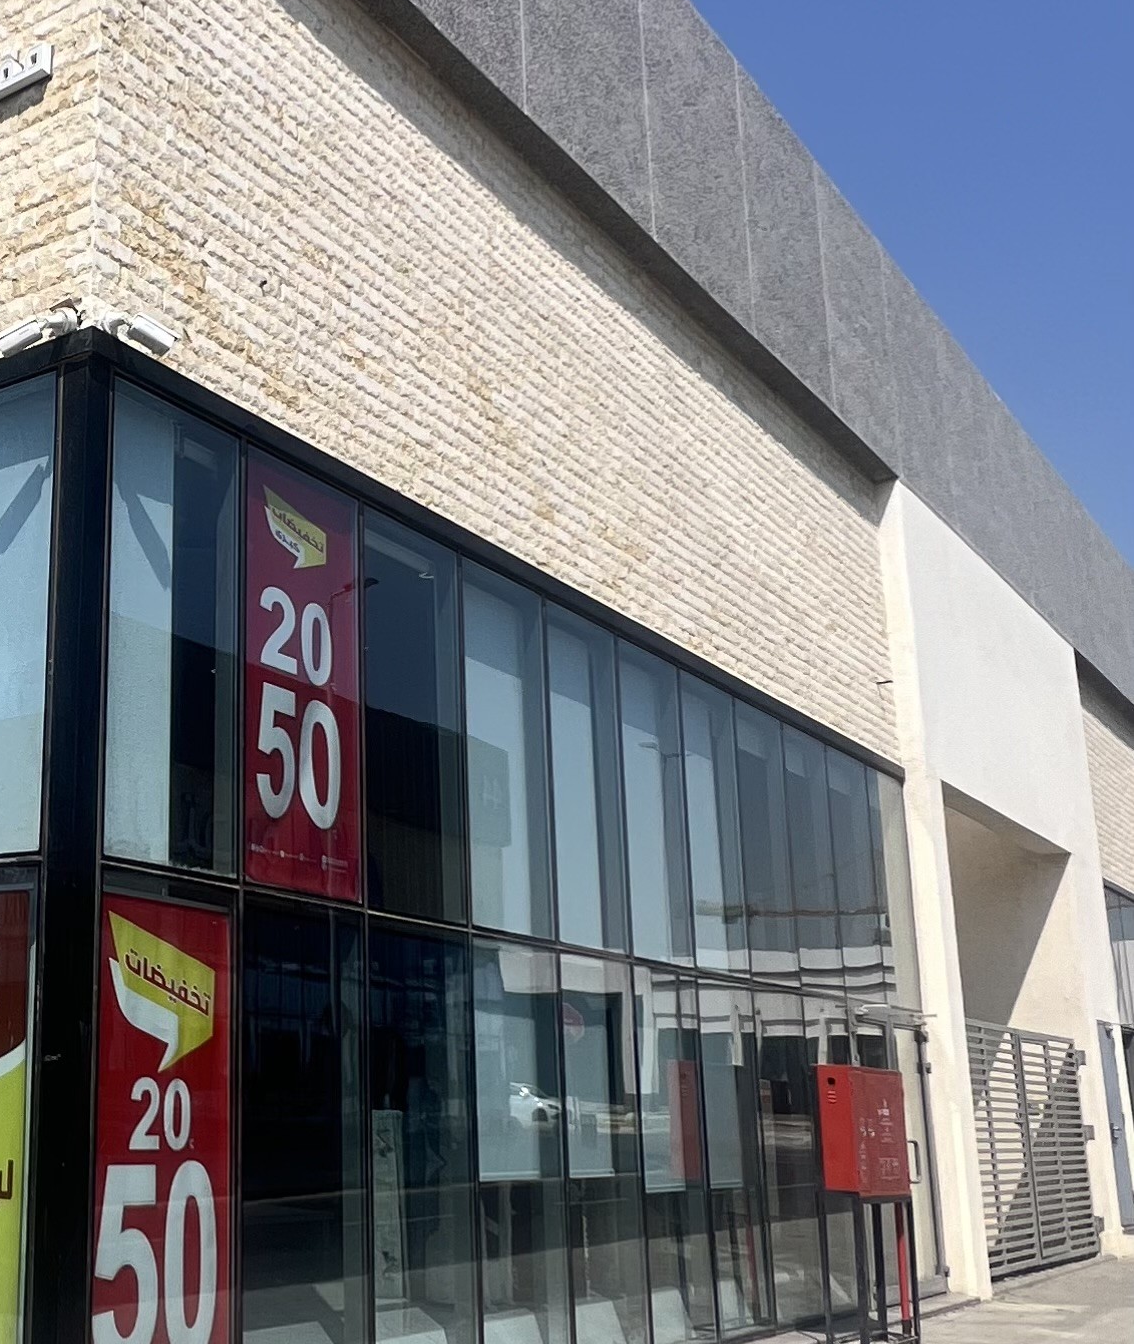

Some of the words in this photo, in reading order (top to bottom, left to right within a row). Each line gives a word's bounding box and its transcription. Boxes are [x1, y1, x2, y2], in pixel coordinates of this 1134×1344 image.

[271, 506, 324, 554] تخفيضات
[259, 585, 333, 686] 20
[255, 681, 341, 830] 50
[124, 948, 211, 1018] تخفيضات
[129, 1076, 191, 1151] 20
